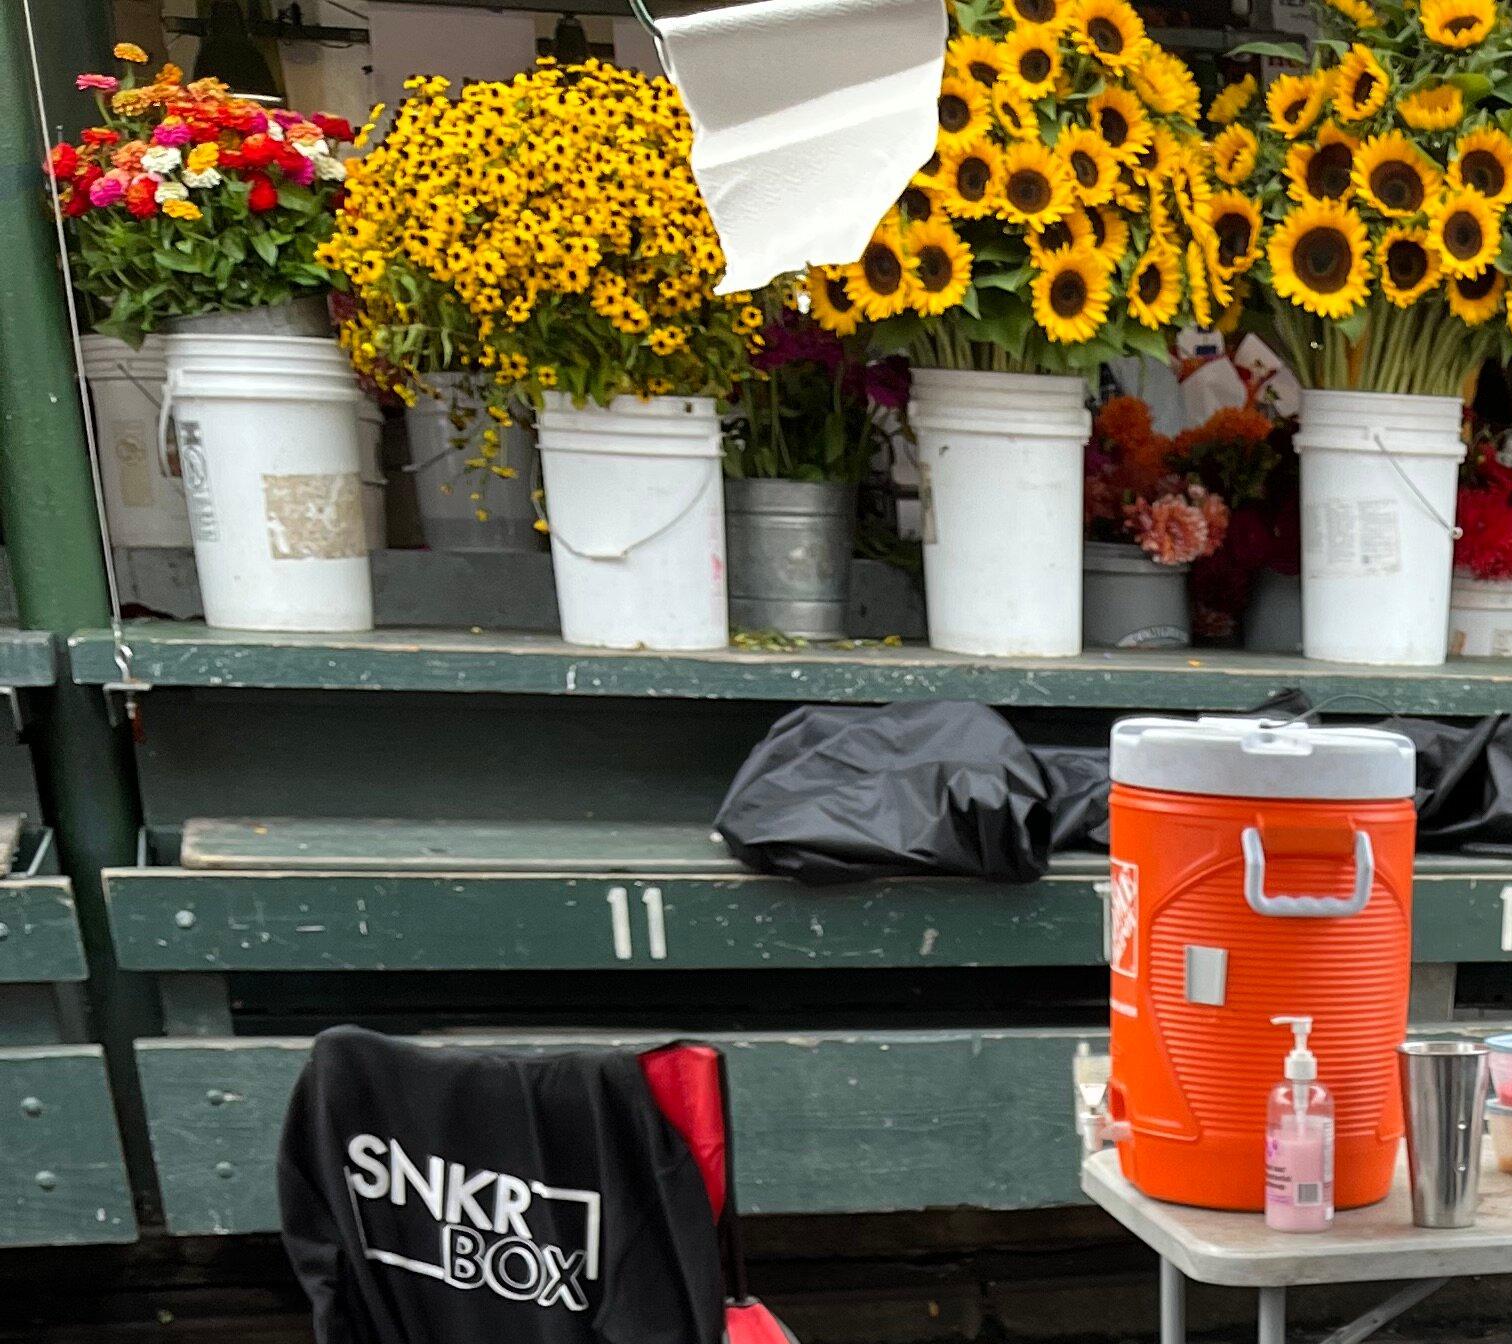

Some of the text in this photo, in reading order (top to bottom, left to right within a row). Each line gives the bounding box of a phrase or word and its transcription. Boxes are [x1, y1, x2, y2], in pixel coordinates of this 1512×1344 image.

[606, 886, 668, 961] 11
[346, 1133, 532, 1241] SNKR
[442, 1223, 590, 1311] BOX
